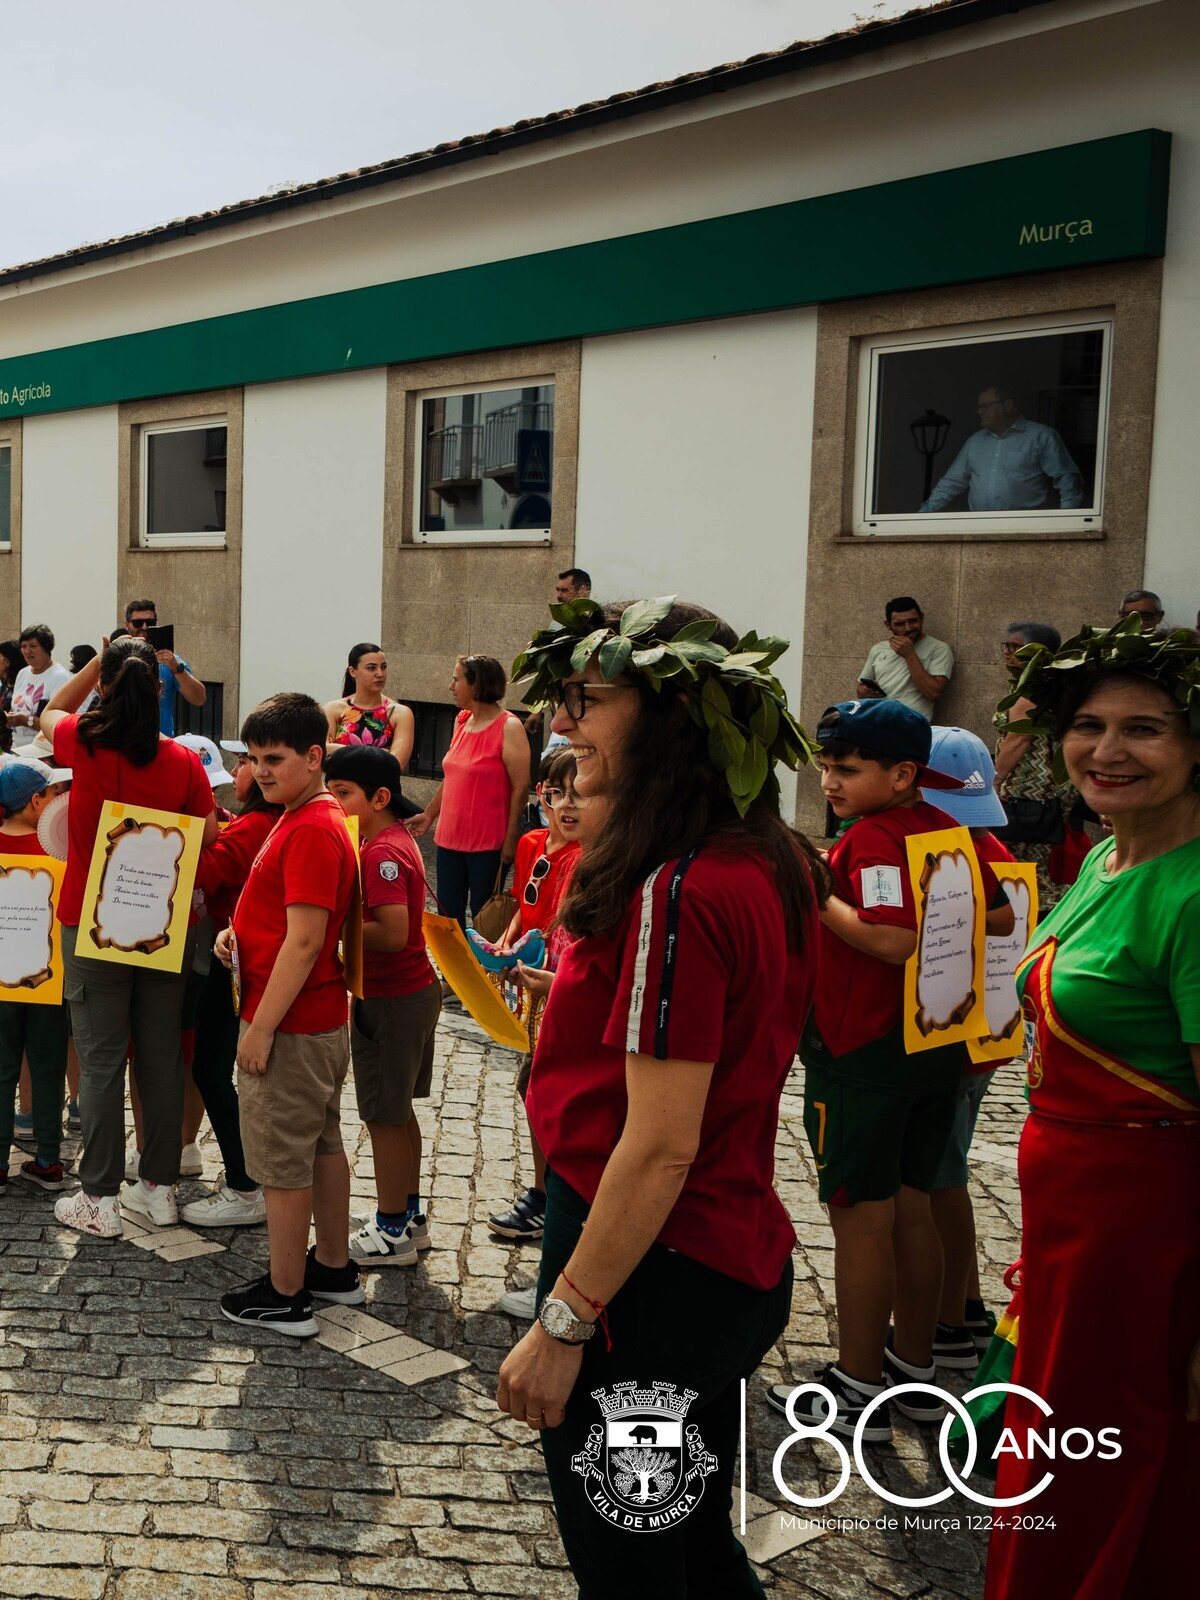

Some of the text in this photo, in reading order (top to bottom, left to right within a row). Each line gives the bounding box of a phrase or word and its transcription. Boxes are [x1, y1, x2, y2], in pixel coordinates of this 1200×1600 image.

[1019, 219, 1093, 245] Murça
[11, 382, 51, 406] Agrícola
[813, 1101, 826, 1155] 7
